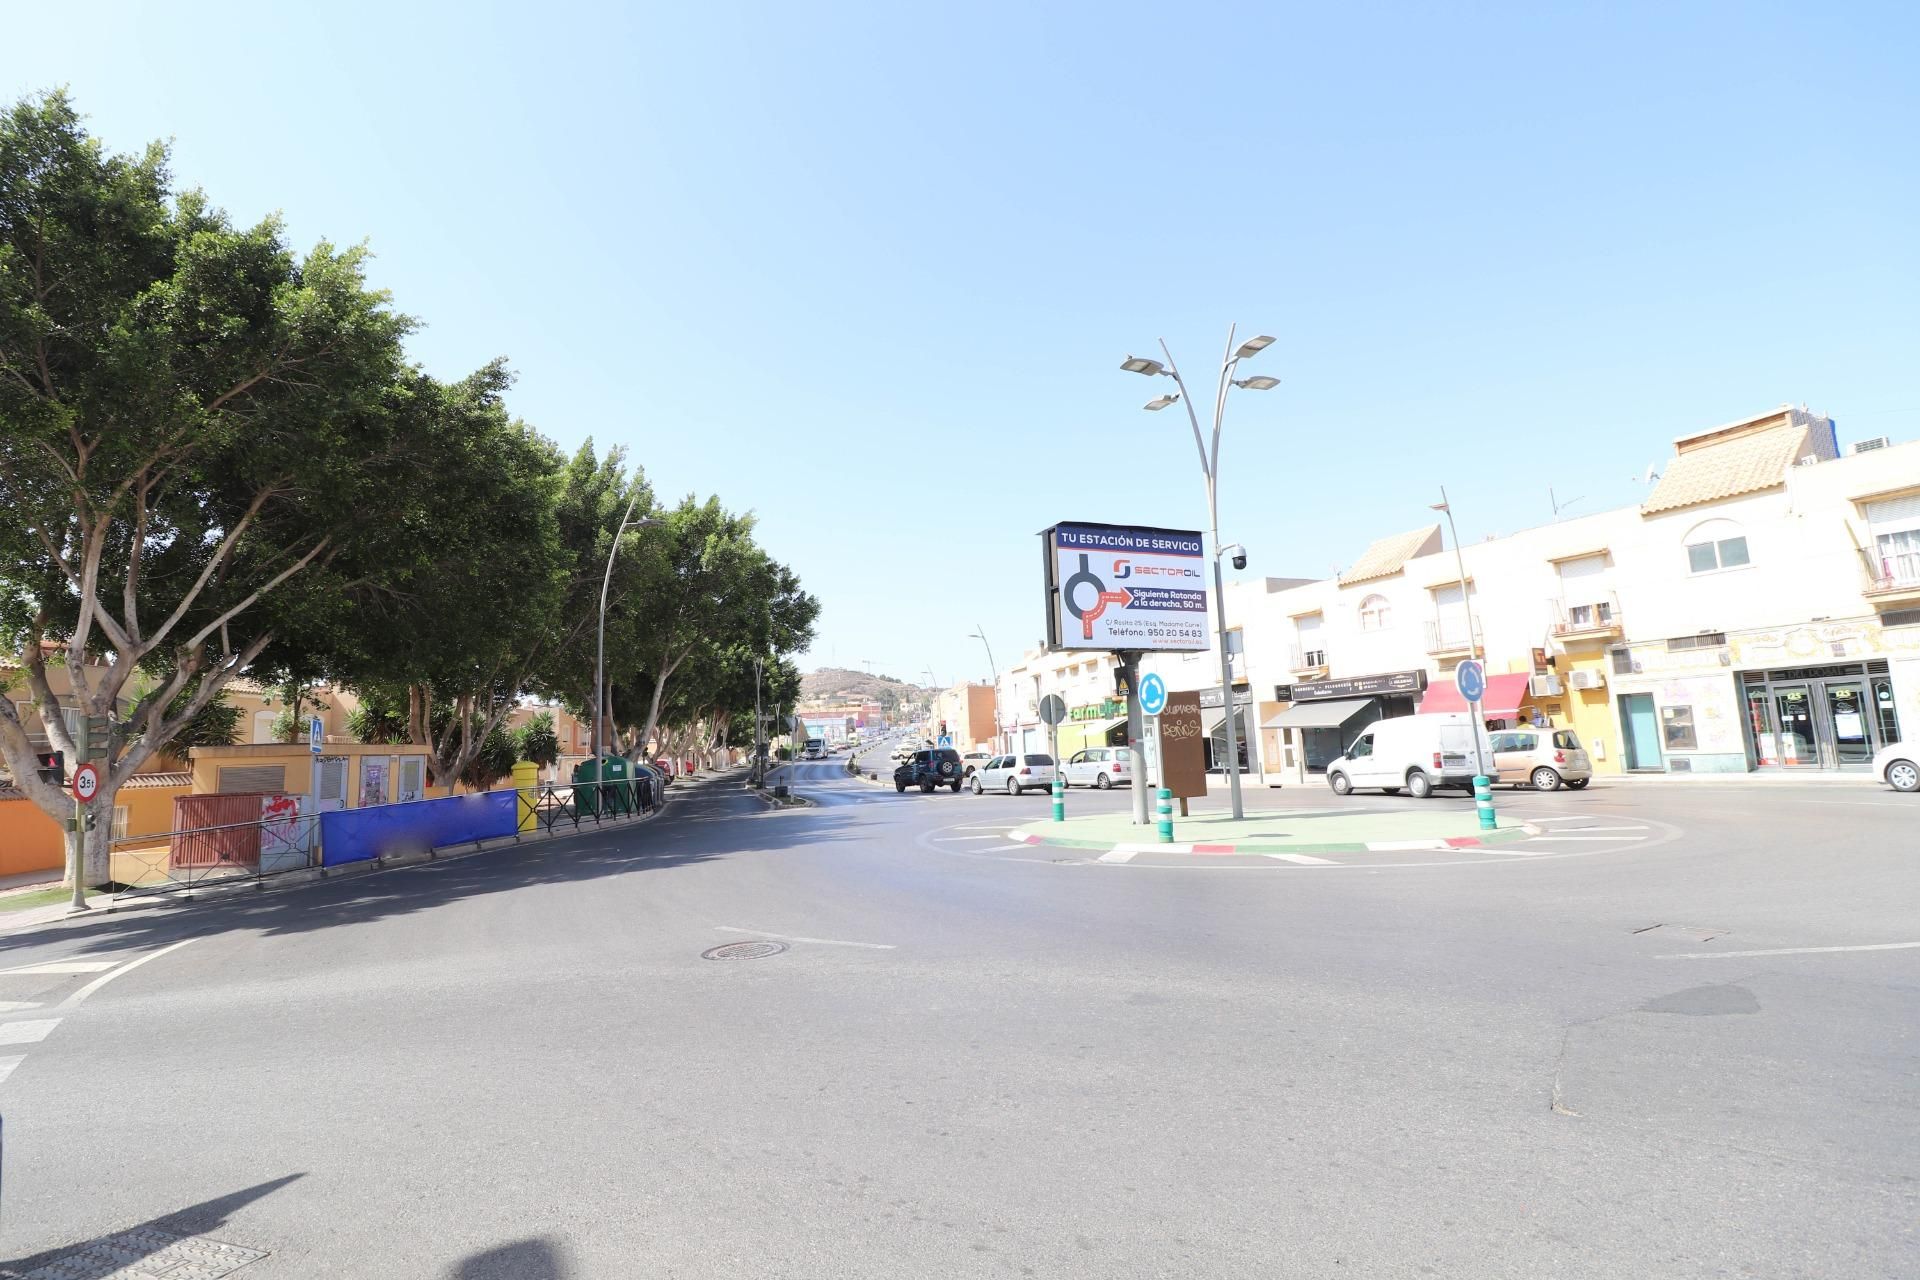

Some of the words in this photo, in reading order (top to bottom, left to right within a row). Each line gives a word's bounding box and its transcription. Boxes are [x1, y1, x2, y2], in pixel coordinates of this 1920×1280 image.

[1062, 533, 1076, 542] TU
[1080, 534, 1133, 546] ESTACIÓN
[1136, 538, 1149, 548] DE
[1152, 540, 1199, 551] SERVICIO
[1135, 566, 1200, 578] SECTOROIL
[1134, 590, 1169, 600] Siguiente
[1170, 592, 1202, 600] Rotonda
[1149, 600, 1182, 608] derecha,
[1108, 628, 1146, 636] Teléfono:
[1148, 628, 1164, 636] 950
[1166, 629, 1177, 637] 20
[1192, 630, 1202, 638] 83
